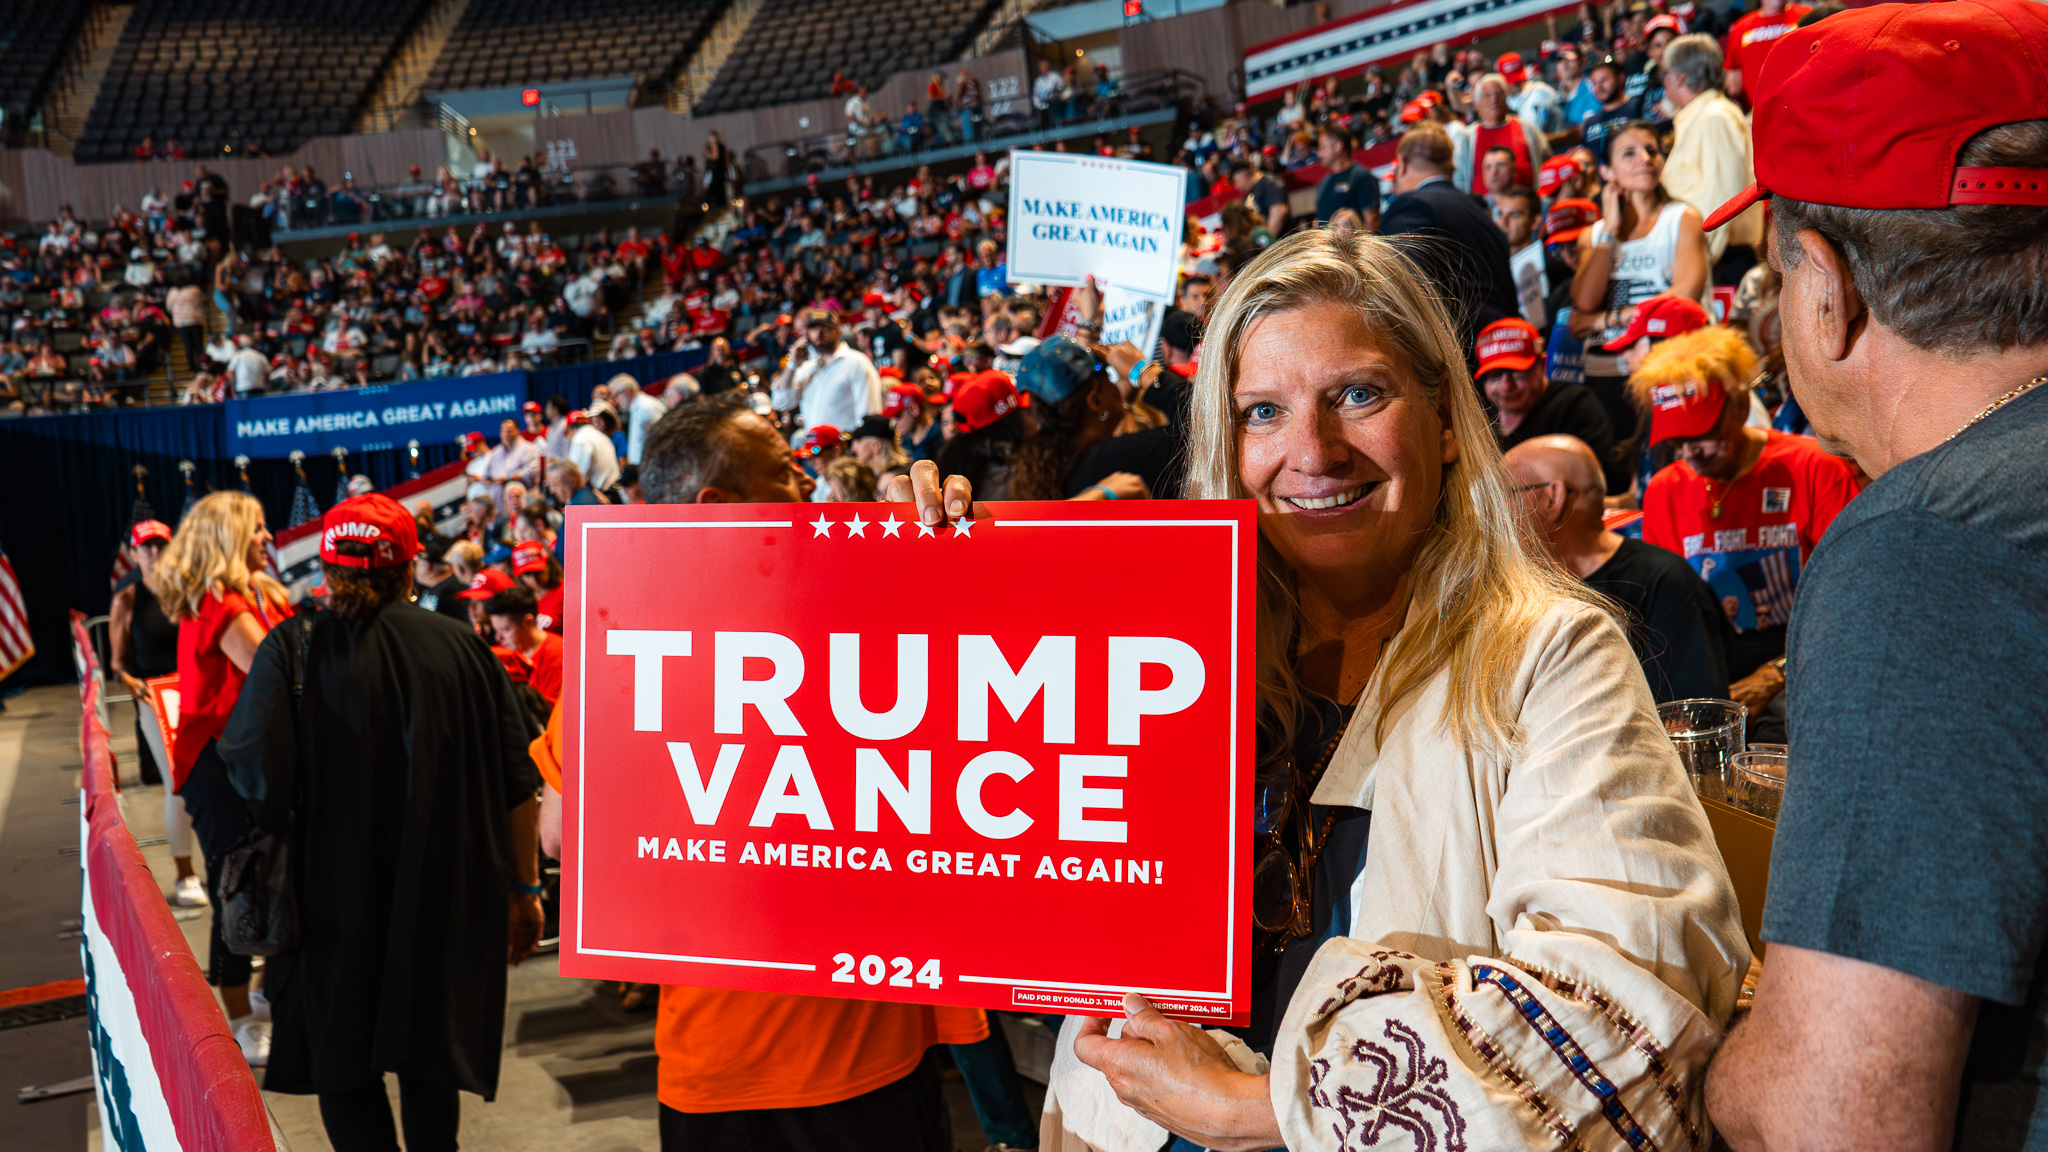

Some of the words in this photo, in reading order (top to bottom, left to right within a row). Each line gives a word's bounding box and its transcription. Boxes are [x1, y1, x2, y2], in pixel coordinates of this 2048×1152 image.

[1022, 198, 1082, 219] MAKE
[1087, 204, 1170, 232] AMERICA
[1032, 222, 1099, 244] GREAT
[1103, 230, 1159, 253] AGAIN
[236, 417, 290, 438] MAKE
[294, 409, 379, 434] AMERICA
[382, 402, 446, 425] GREAT
[449, 393, 517, 419] AGAIN!
[323, 521, 381, 552] TRUMP
[606, 630, 1206, 746] TRUMP
[667, 741, 1128, 843] VANCE
[637, 836, 726, 863] MAKE
[739, 841, 893, 873] AMERICA
[906, 849, 1021, 878] GREAT
[1035, 855, 1164, 886] AGAIN!
[832, 952, 943, 990] 2024
[1017, 993, 1036, 1001] PAID
[1036, 994, 1052, 1002] FOR
[1052, 995, 1063, 1003] BY
[1063, 996, 1095, 1006] DONALD
[1095, 998, 1103, 1006] J.
[1103, 999, 1124, 1007] TRUM
[1152, 1002, 1189, 1011] RESIDENT
[1189, 1004, 1210, 1014] 2024,
[1211, 1006, 1227, 1014] INC.
